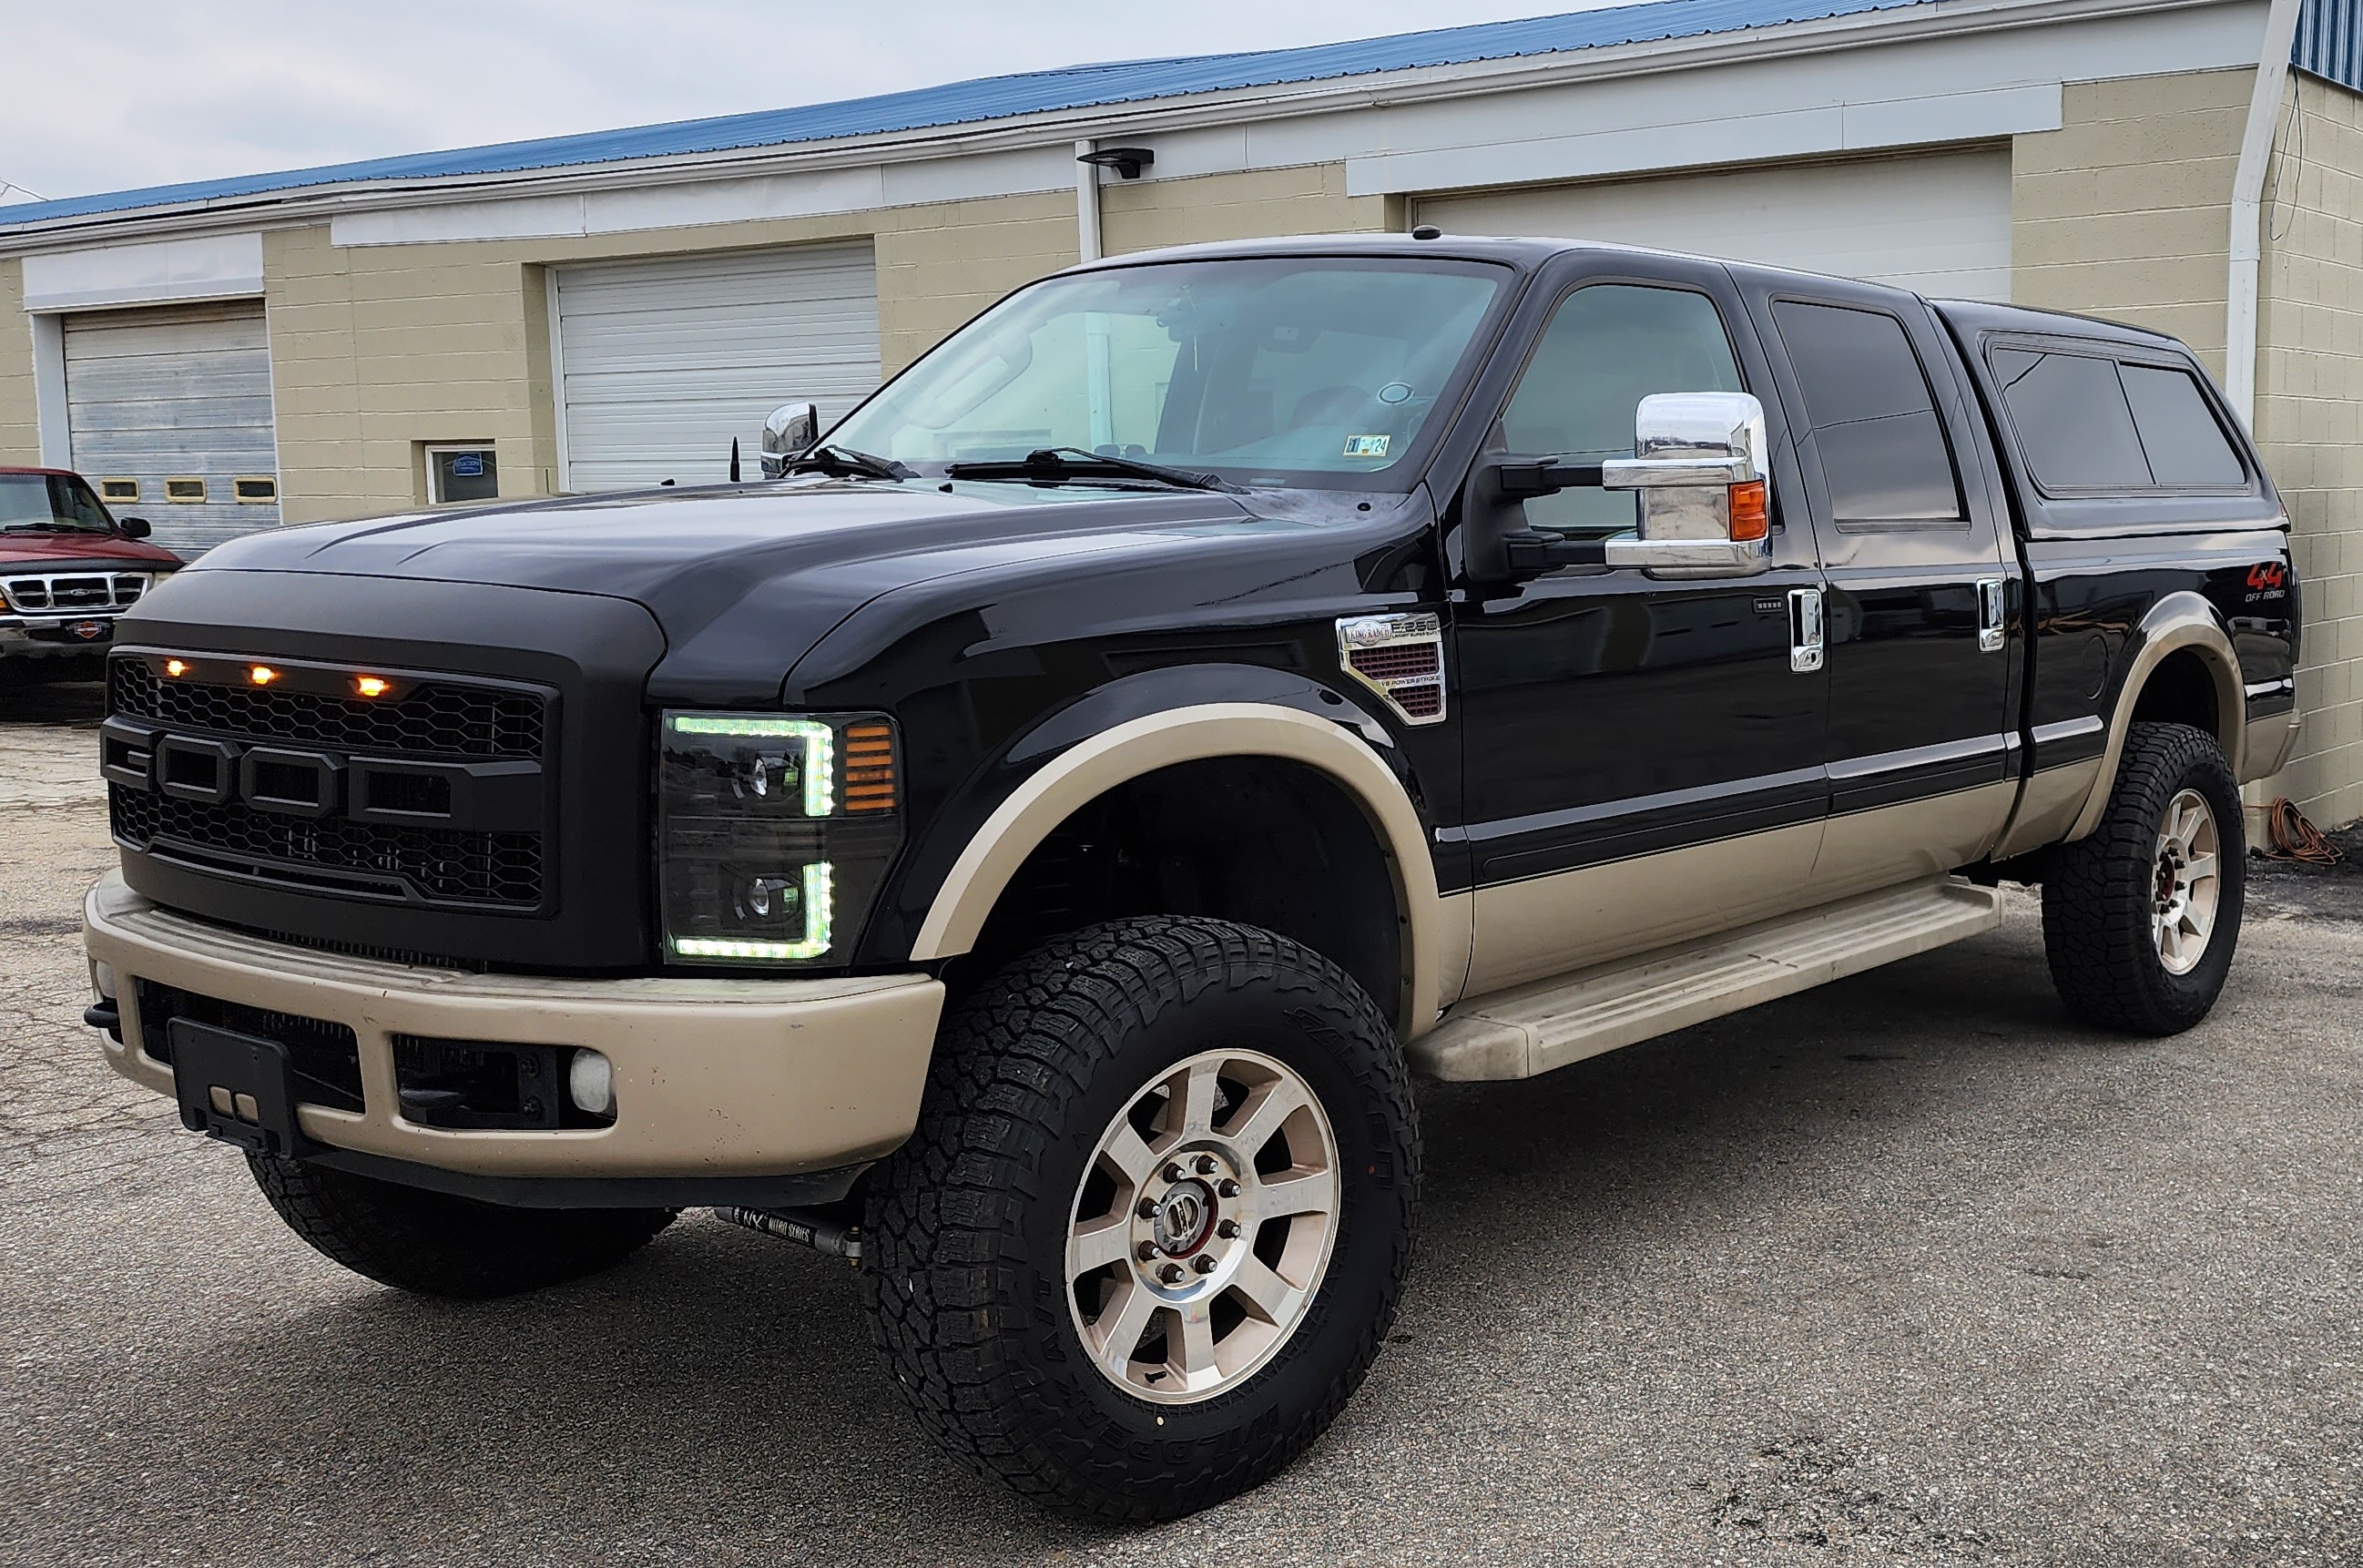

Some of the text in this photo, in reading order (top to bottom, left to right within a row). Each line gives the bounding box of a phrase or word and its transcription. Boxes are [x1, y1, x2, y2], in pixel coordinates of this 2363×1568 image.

[1374, 438, 1387, 453] 24
[2246, 590, 2285, 602] OFF ROAD
[1350, 628, 1366, 640] KING
[1368, 626, 1390, 638] RANCH
[769, 1217, 788, 1235] NITRO
[789, 1224, 810, 1242] SERIES
